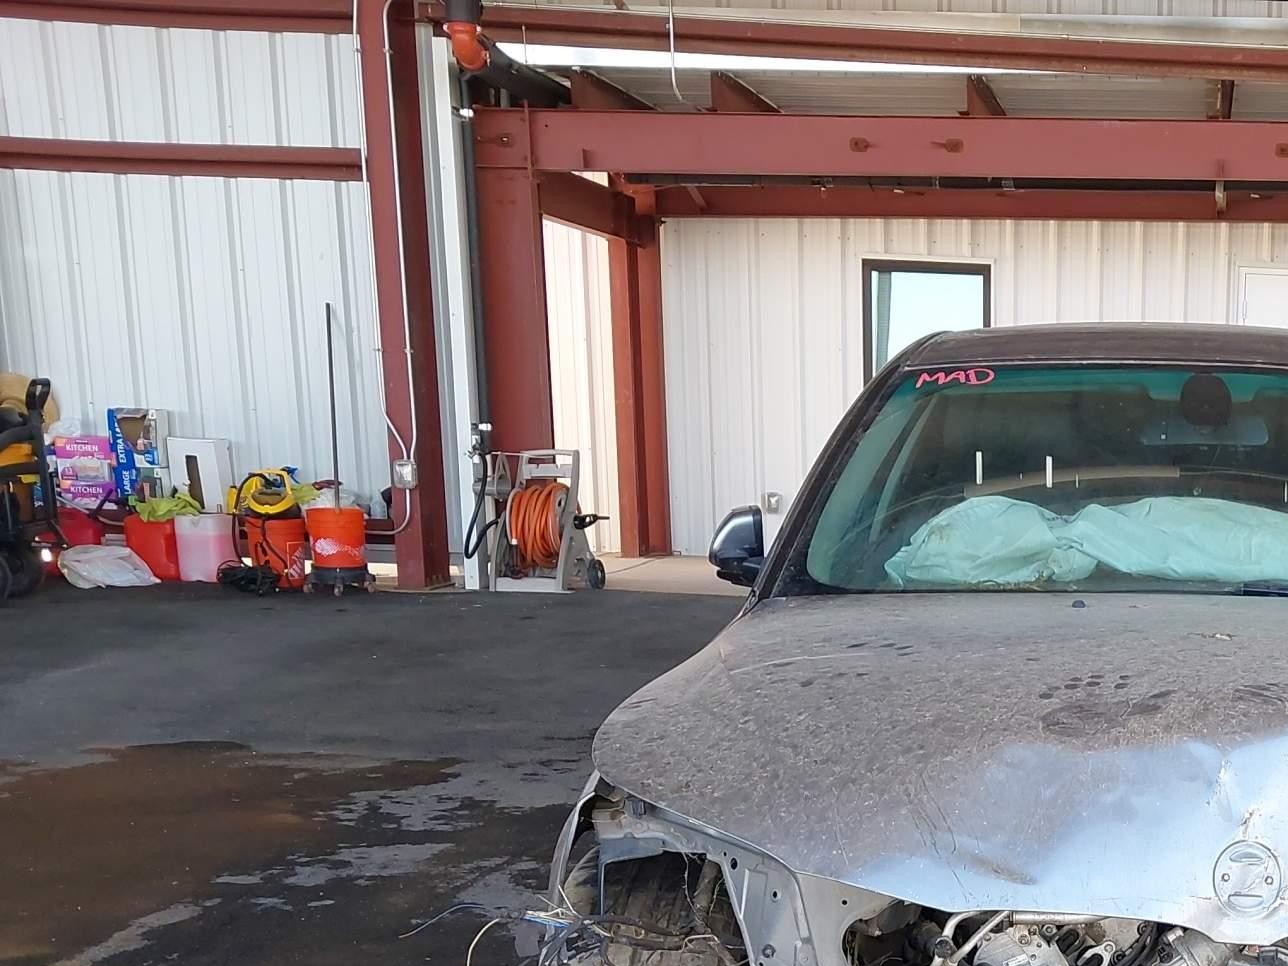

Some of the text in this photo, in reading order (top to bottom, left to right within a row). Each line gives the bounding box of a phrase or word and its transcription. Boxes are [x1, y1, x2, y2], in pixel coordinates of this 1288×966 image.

[915, 367, 996, 389] MAD
[65, 444, 99, 452] KITCHEN
[117, 438, 127, 463] EXTRA
[70, 486, 103, 494] KITCHEN
[122, 470, 132, 494] LARGE
